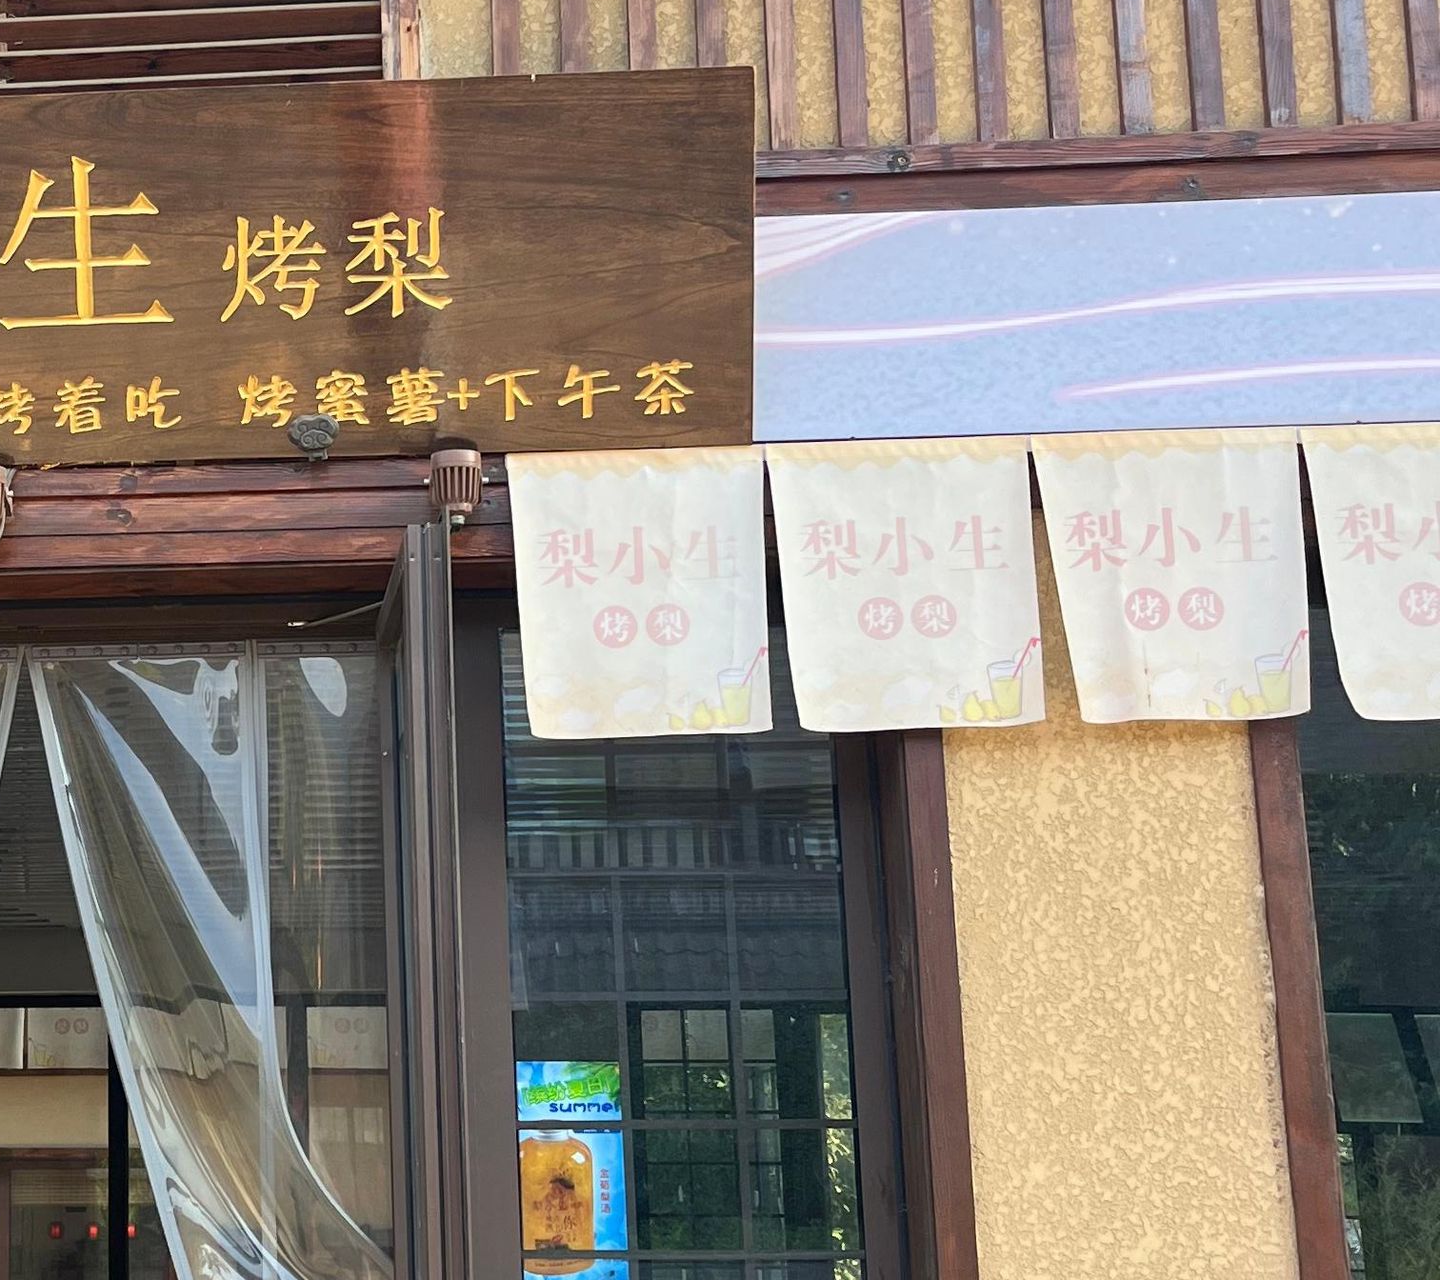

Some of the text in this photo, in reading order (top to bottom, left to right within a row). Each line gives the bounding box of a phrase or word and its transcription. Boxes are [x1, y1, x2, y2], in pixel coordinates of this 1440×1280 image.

[221, 206, 454, 323] 烤梨
[236, 358, 696, 428] 烤蜜薯+下午茶
[537, 525, 742, 589] 梨小生
[799, 515, 1010, 581] 梨小生
[1064, 506, 1279, 573] 梨小生
[595, 605, 689, 646] 烤梨
[860, 596, 956, 638] 烤梨
[1127, 588, 1223, 630] 烤梨
